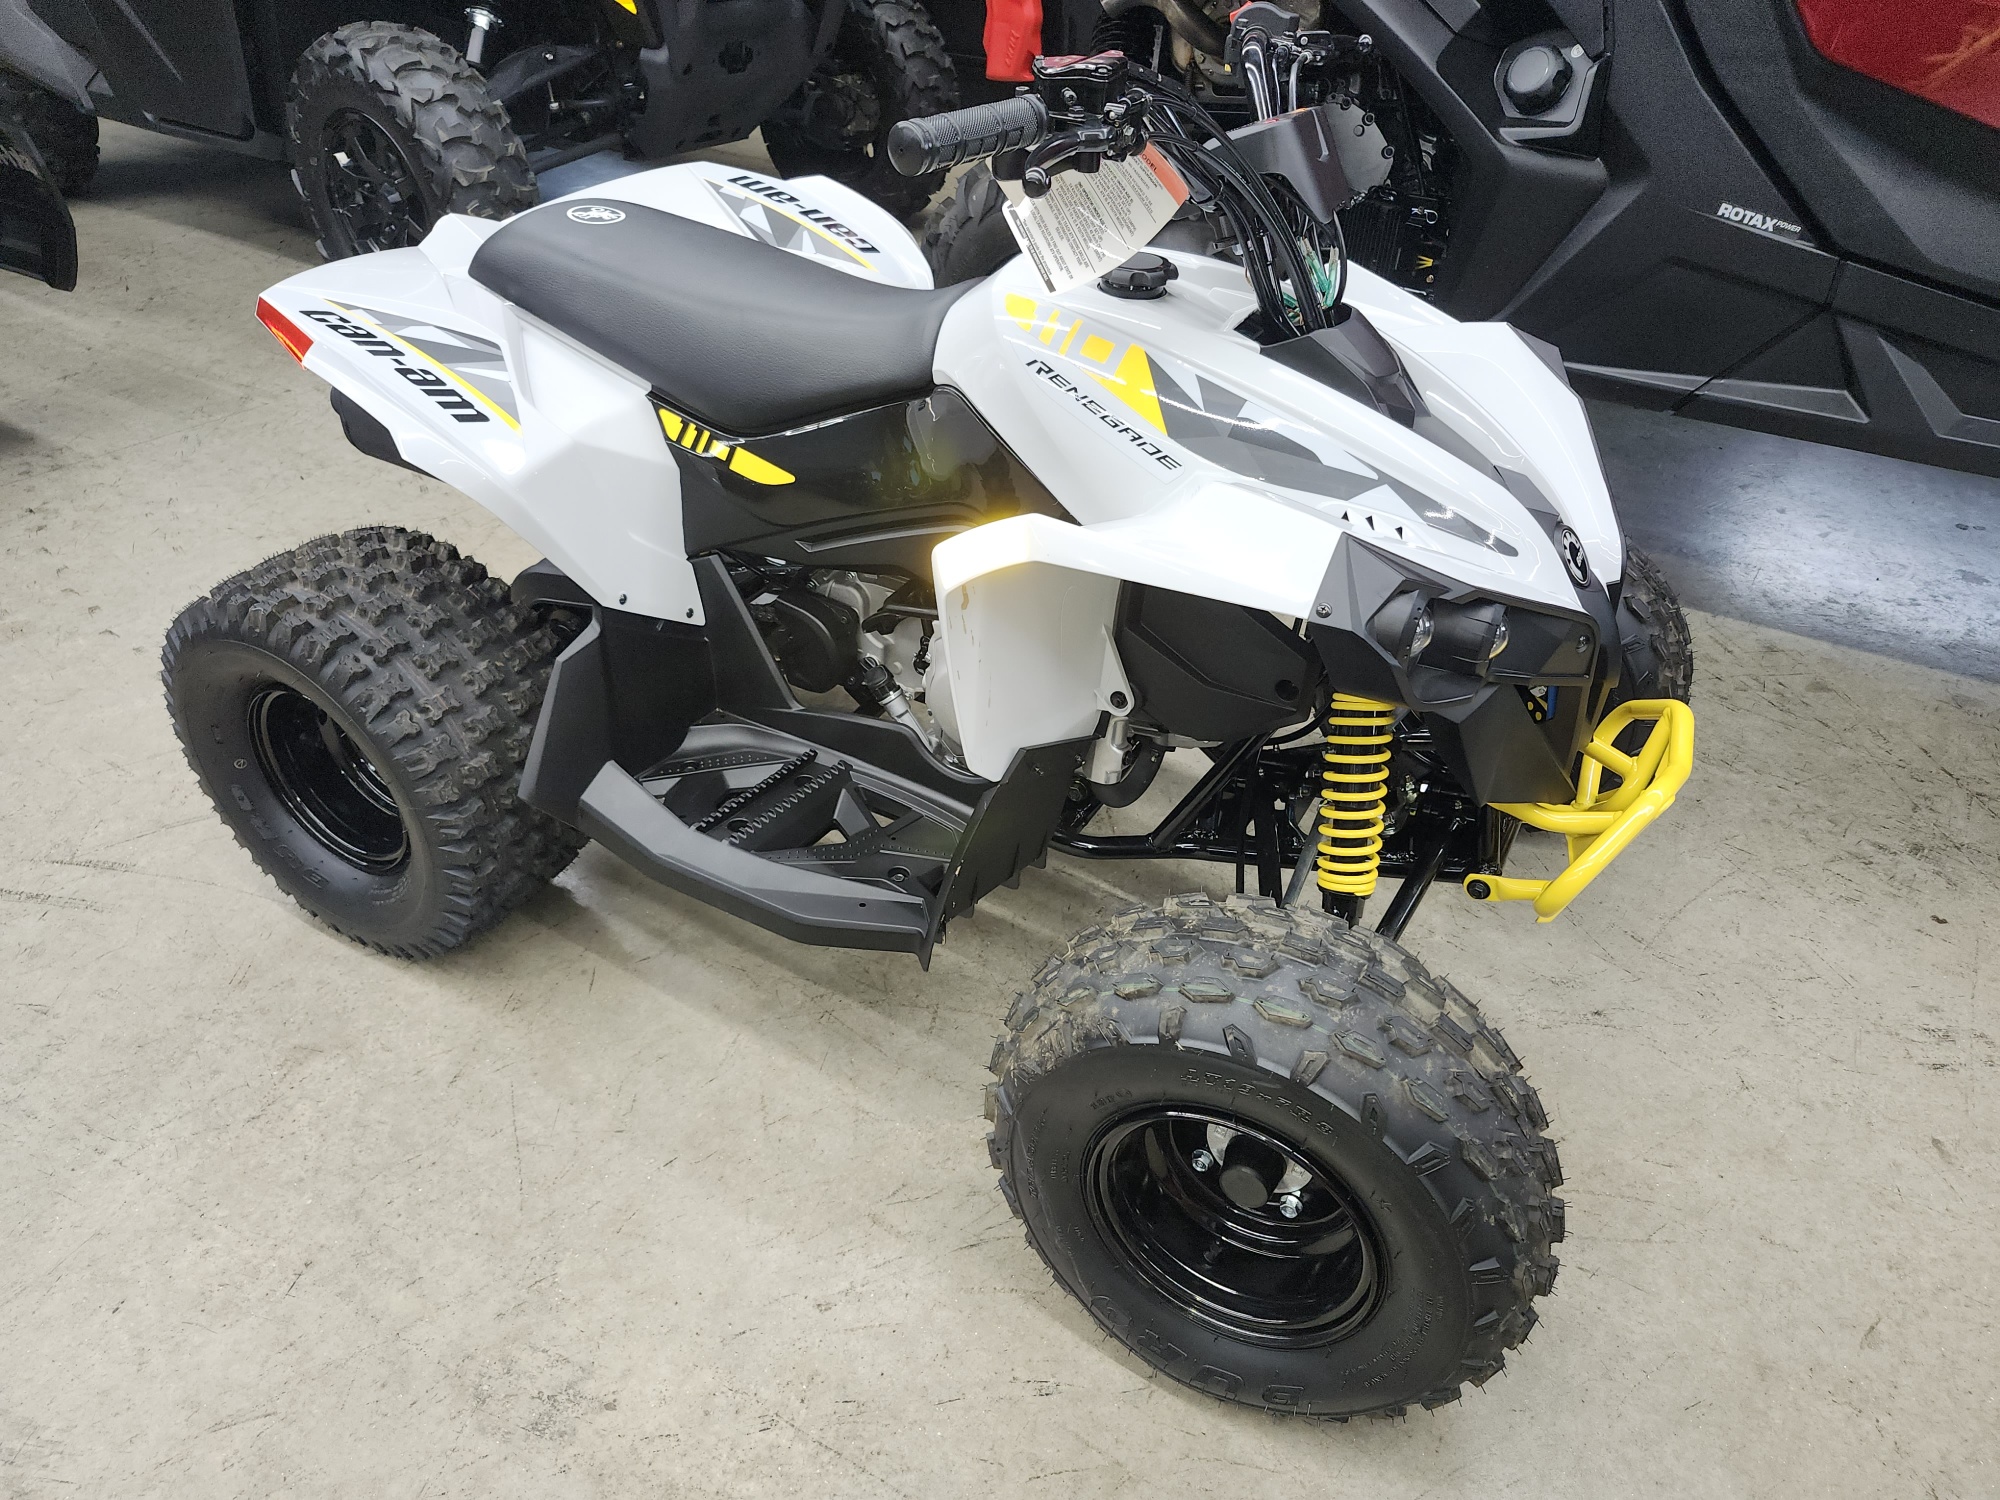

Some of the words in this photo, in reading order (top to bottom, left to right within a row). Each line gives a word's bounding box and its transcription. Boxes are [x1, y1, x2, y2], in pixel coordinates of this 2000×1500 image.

[727, 175, 881, 254] can-am
[1716, 202, 1778, 232] ROTAX
[1776, 220, 1802, 233] POWER
[298, 310, 491, 423] can-am
[1025, 358, 1183, 472] RENEGADE
